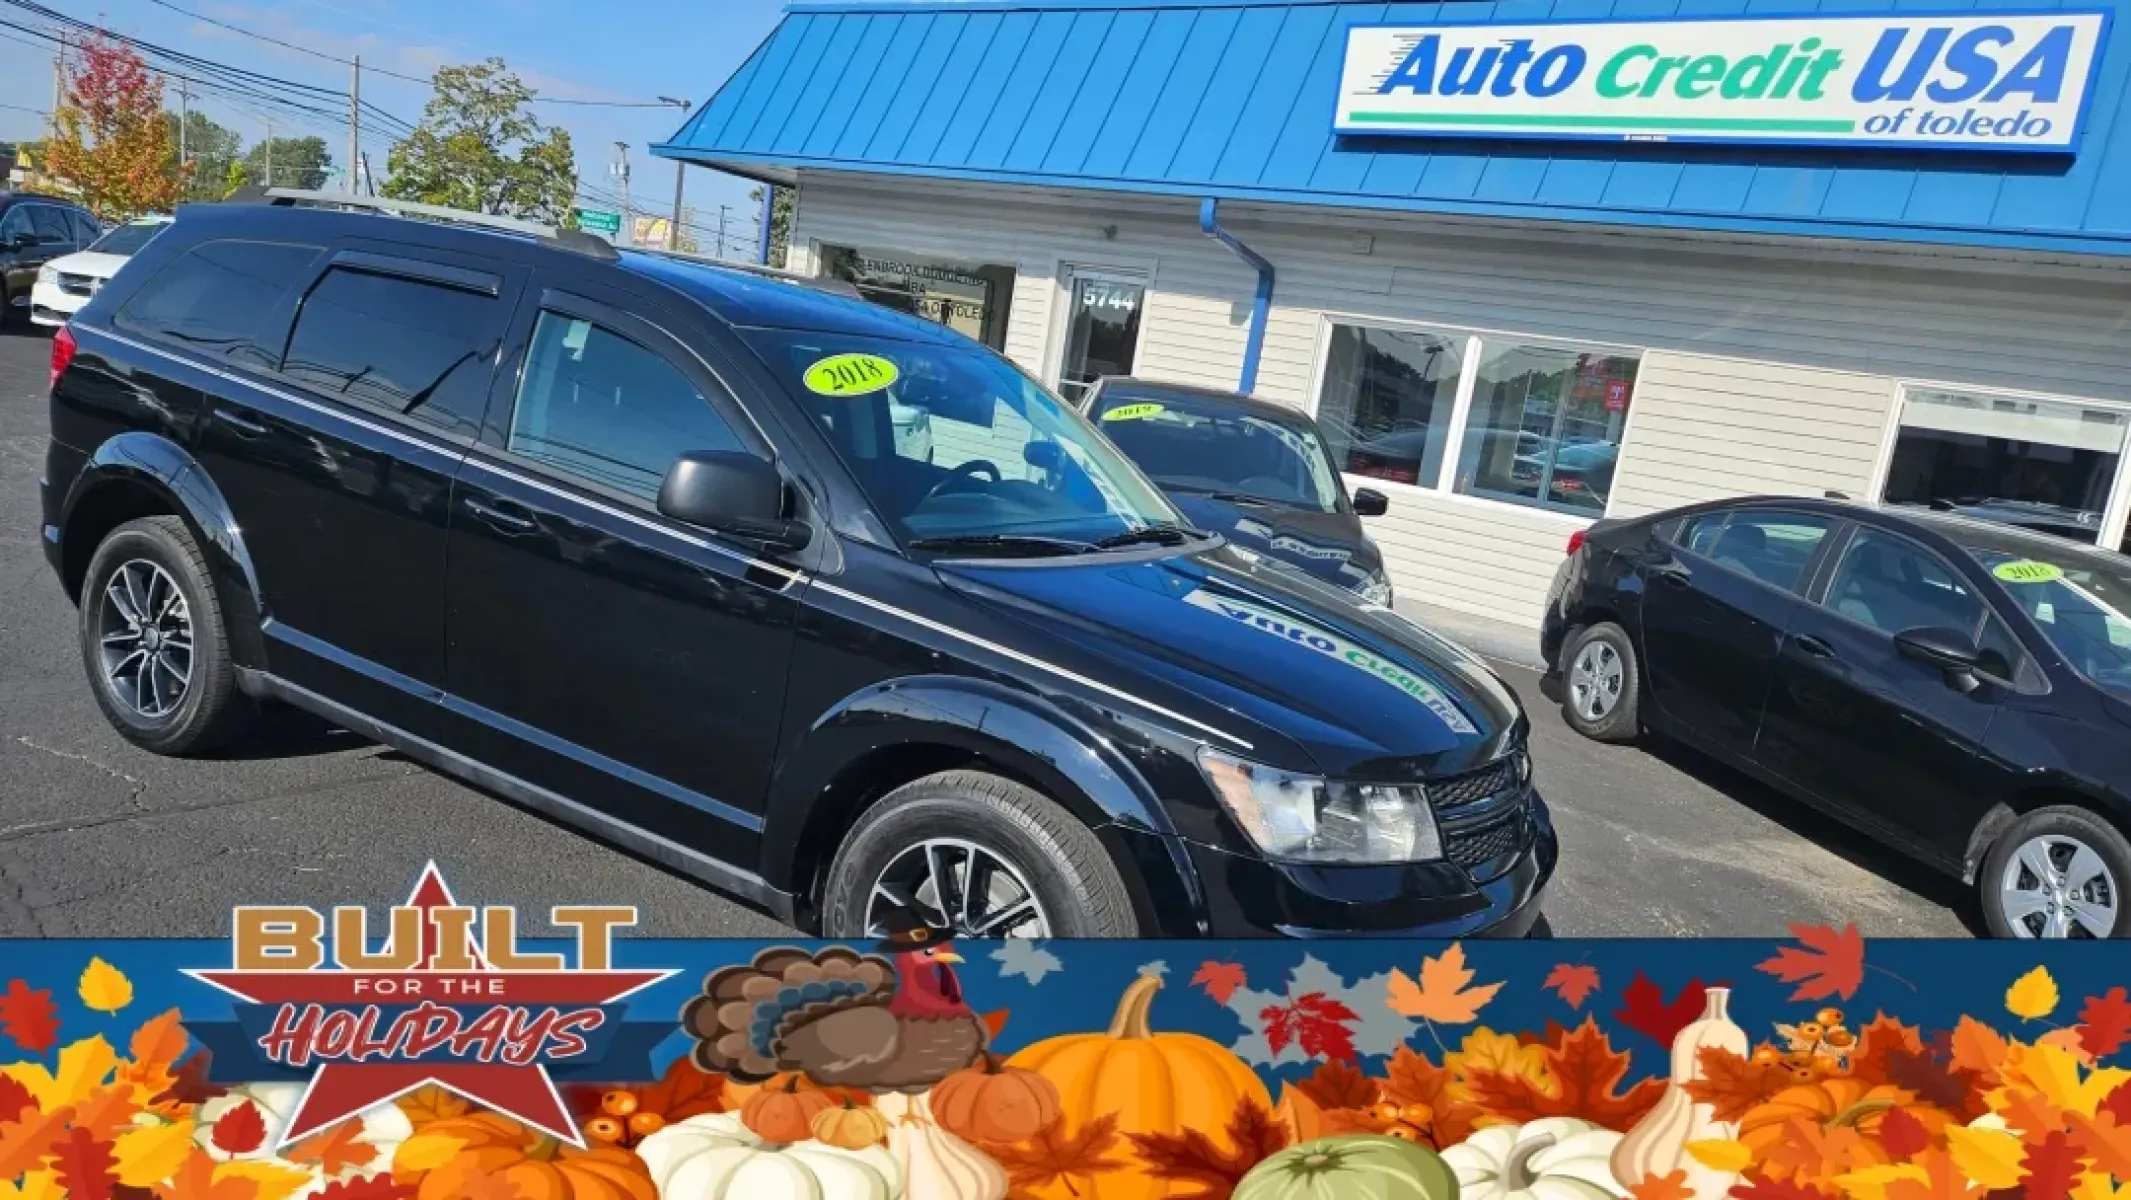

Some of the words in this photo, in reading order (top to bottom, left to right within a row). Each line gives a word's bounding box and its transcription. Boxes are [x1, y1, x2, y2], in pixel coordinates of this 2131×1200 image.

[1372, 33, 1587, 98] Auto
[1594, 37, 1844, 100] Credit
[1851, 25, 2076, 104] USA
[1863, 108, 1912, 137] of
[1915, 108, 2052, 139] toledo
[1082, 287, 1136, 311] 5744
[821, 358, 884, 392] 2018
